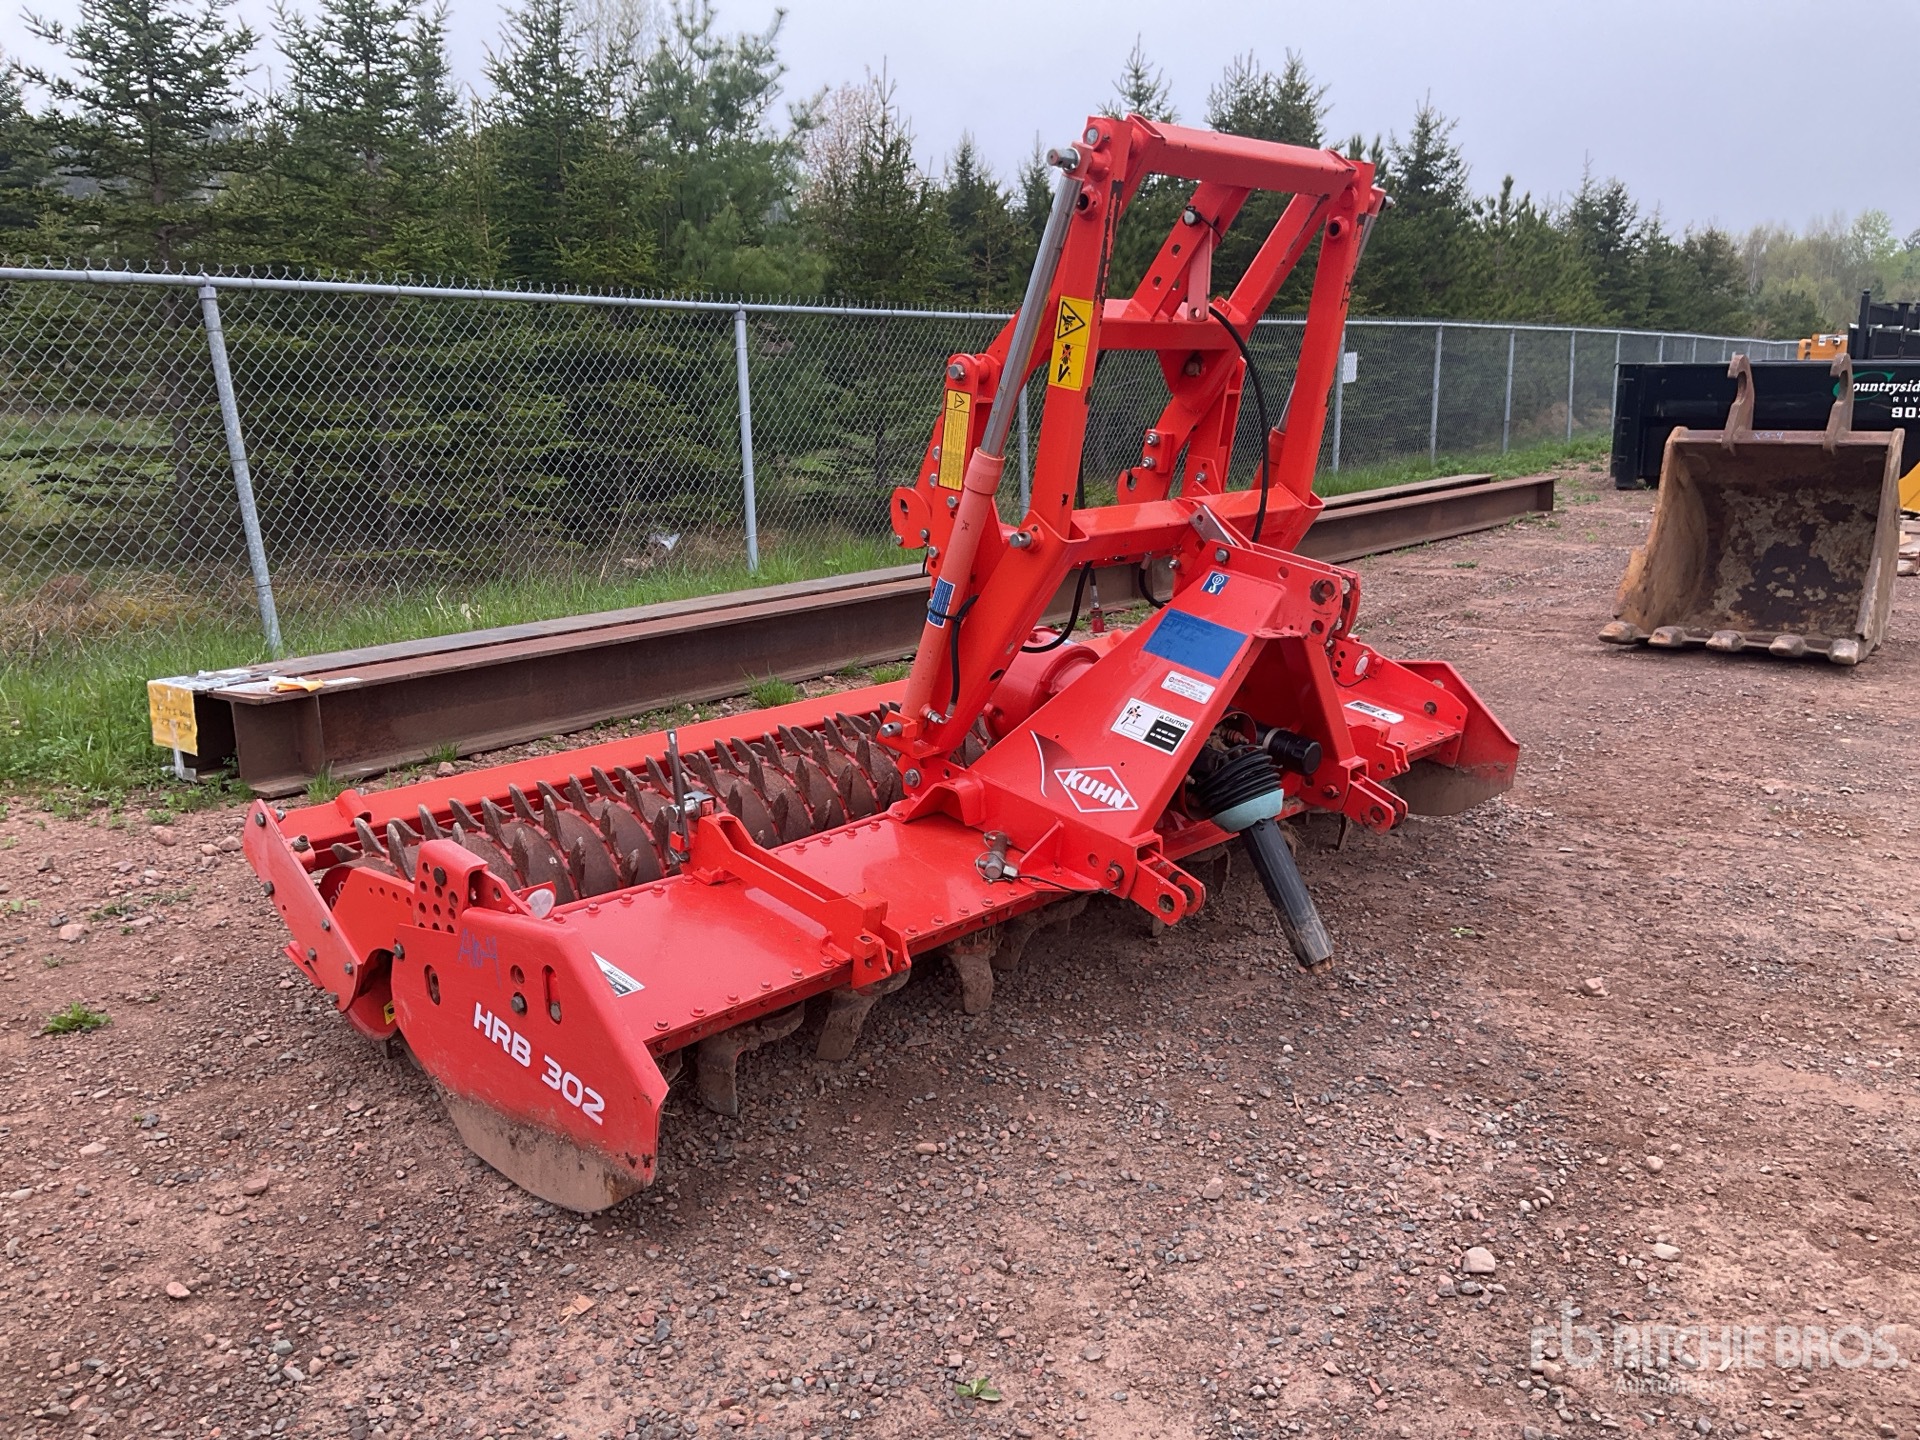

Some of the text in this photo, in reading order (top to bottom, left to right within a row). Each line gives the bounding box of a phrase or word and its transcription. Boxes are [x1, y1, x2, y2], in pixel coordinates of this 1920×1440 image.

[1891, 406, 1920, 419] 90
[1165, 715, 1189, 729] CAUTION
[1062, 769, 1130, 810] KUHN
[473, 1001, 606, 1126] HRB 302
